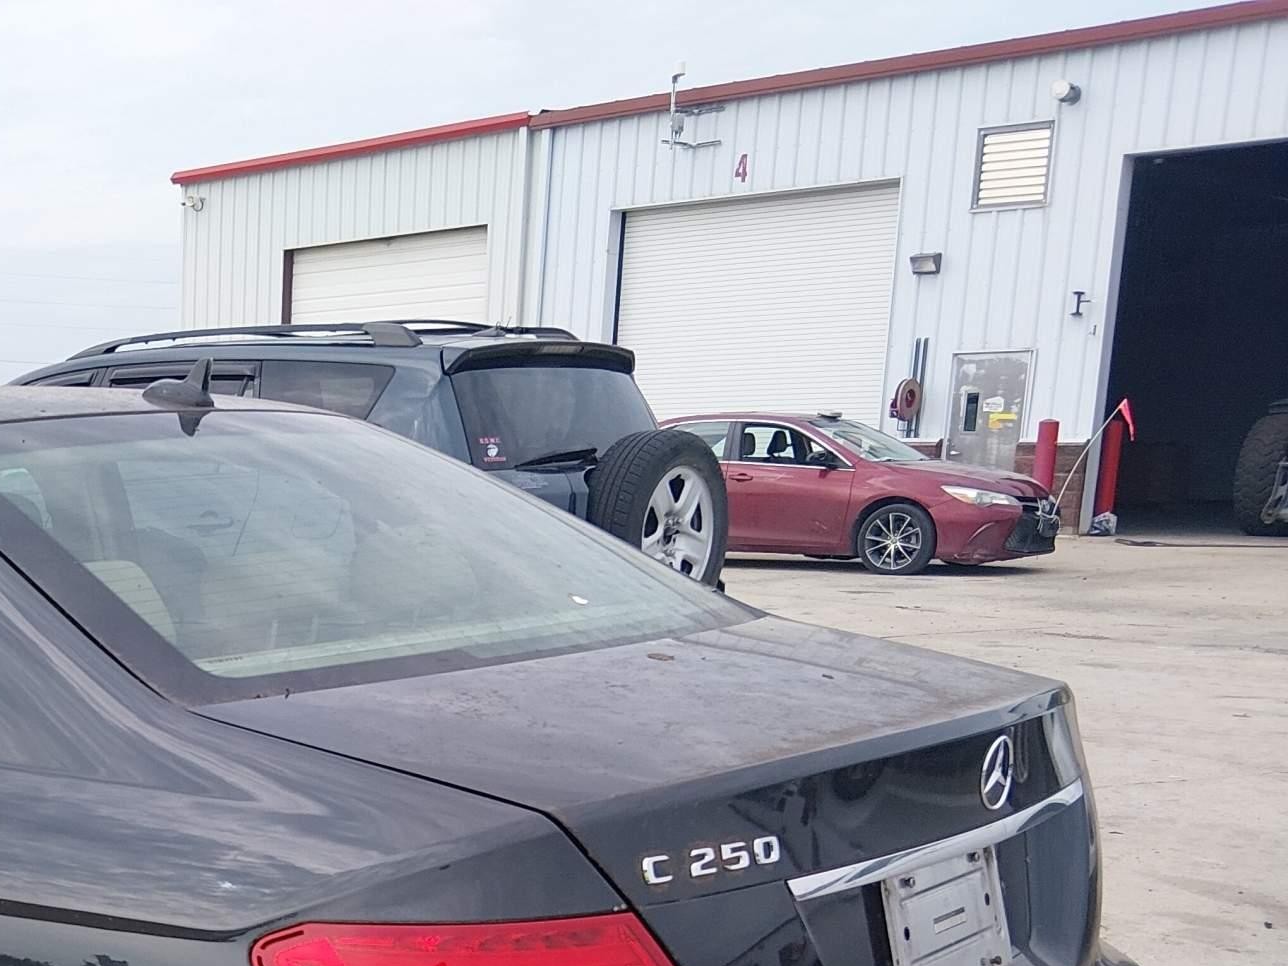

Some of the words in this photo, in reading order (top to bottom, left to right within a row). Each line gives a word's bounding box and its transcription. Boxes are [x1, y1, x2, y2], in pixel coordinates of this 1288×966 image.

[734, 153, 748, 183] 4
[641, 854, 674, 885] C
[689, 835, 781, 878] 250
